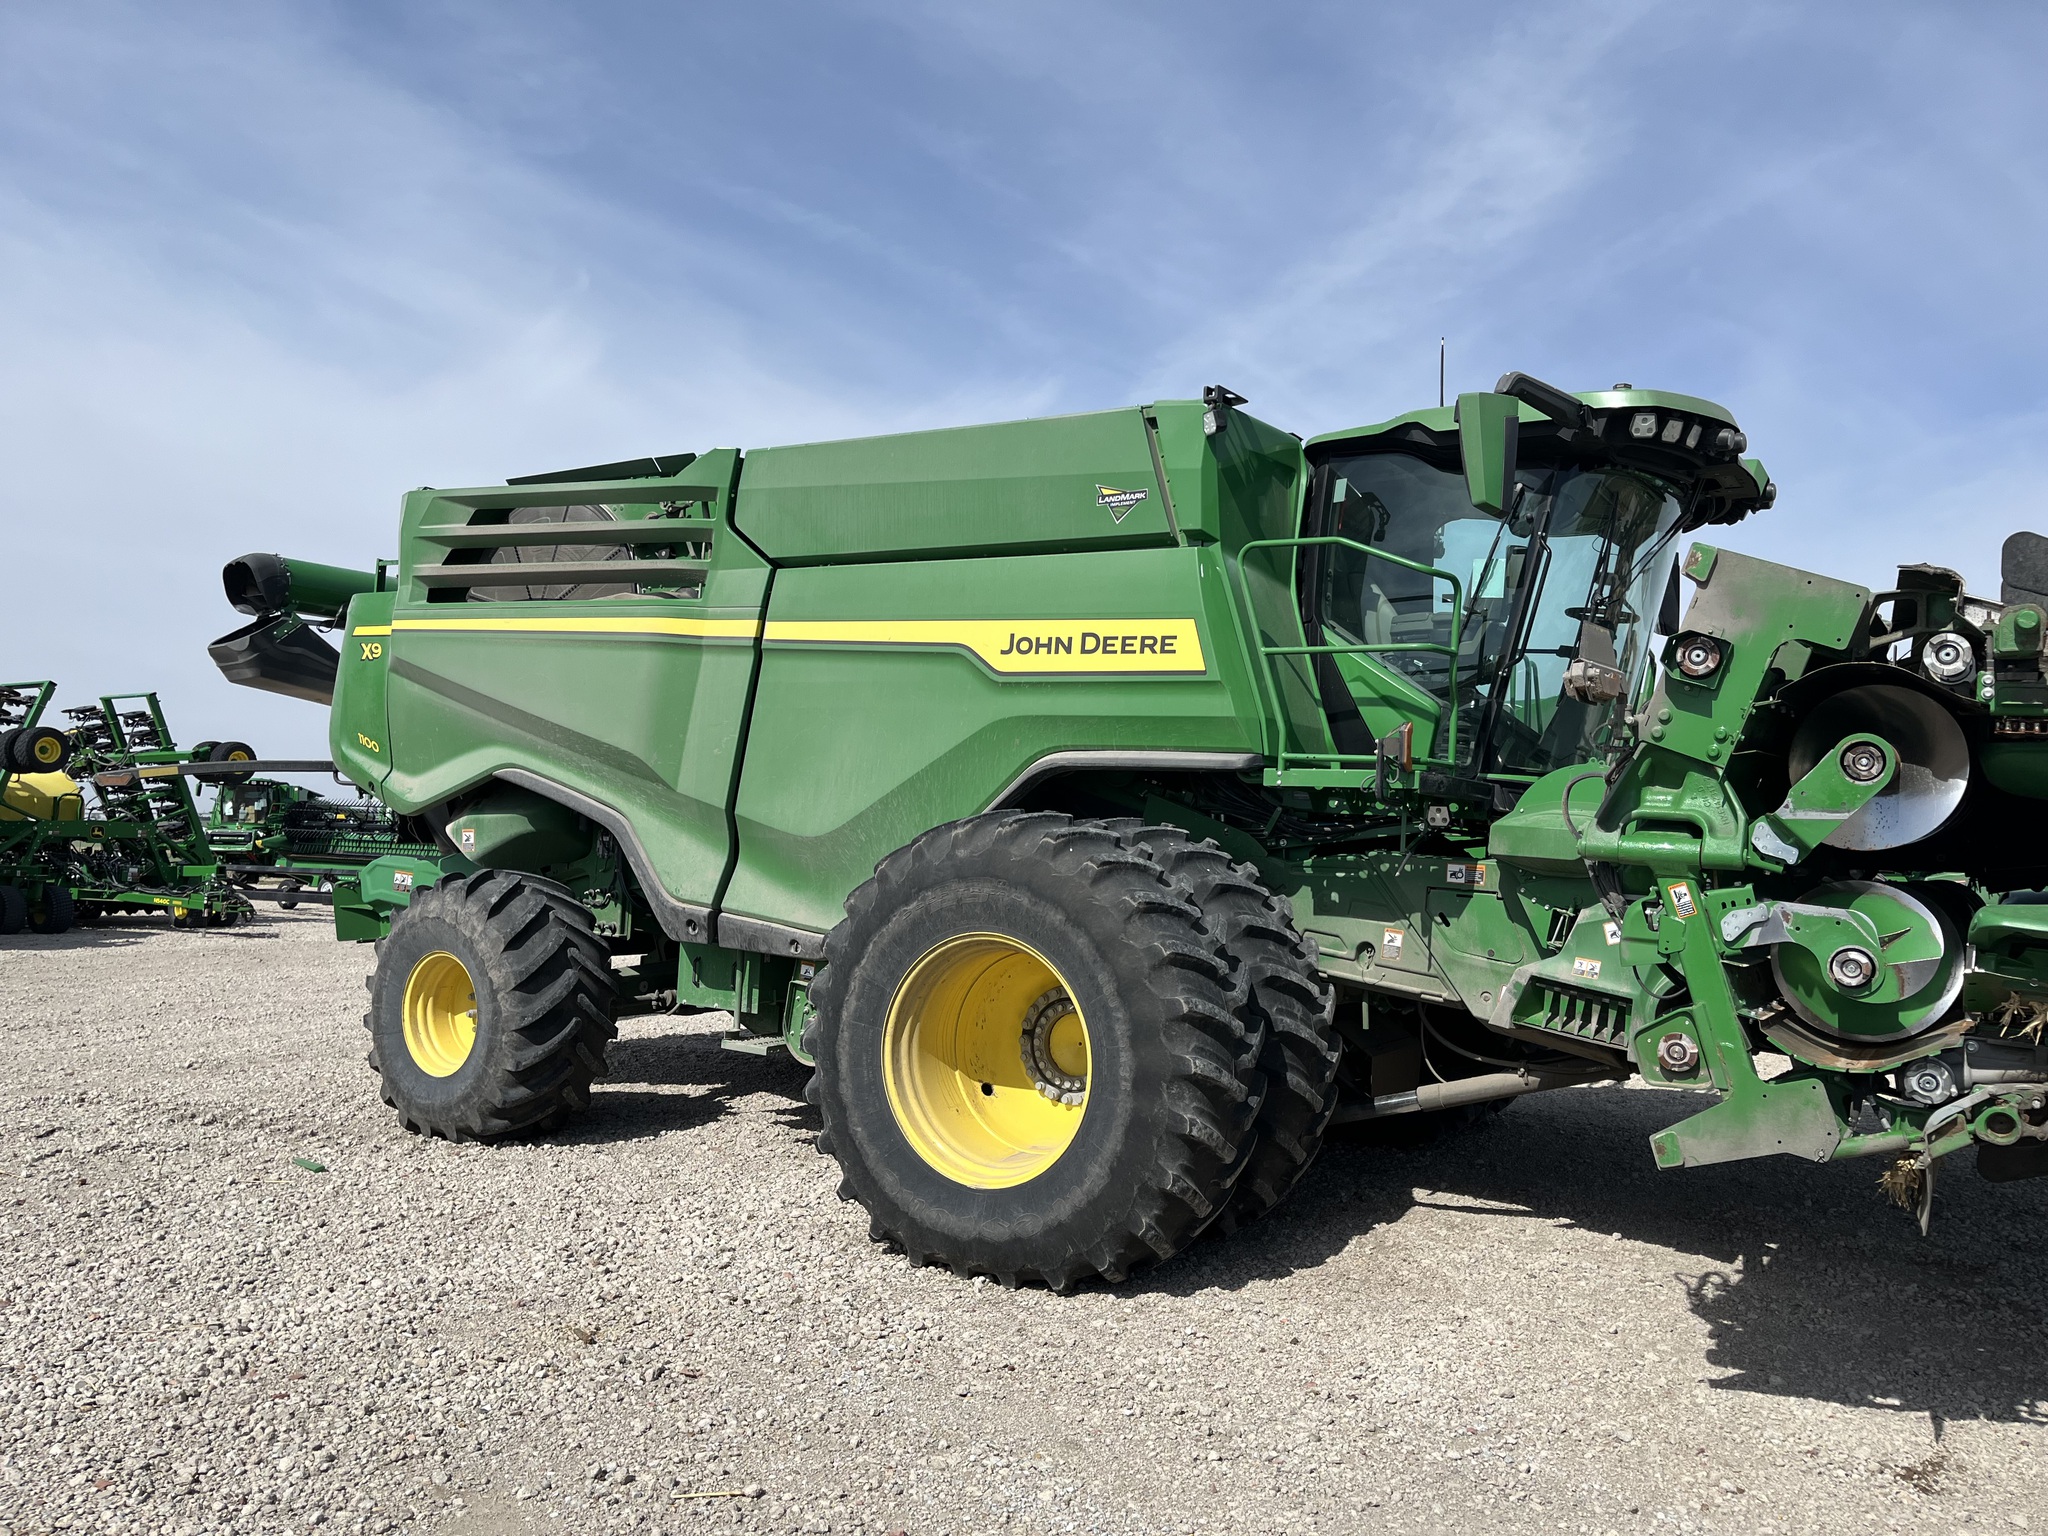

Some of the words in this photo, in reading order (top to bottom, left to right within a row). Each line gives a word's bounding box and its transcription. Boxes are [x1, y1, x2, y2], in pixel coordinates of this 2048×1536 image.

[1098, 492, 1147, 504] LANDMARK
[360, 642, 383, 661] X9
[1000, 633, 1073, 655] JOHN
[1080, 632, 1178, 655] DEERE
[357, 732, 380, 753] 1100
